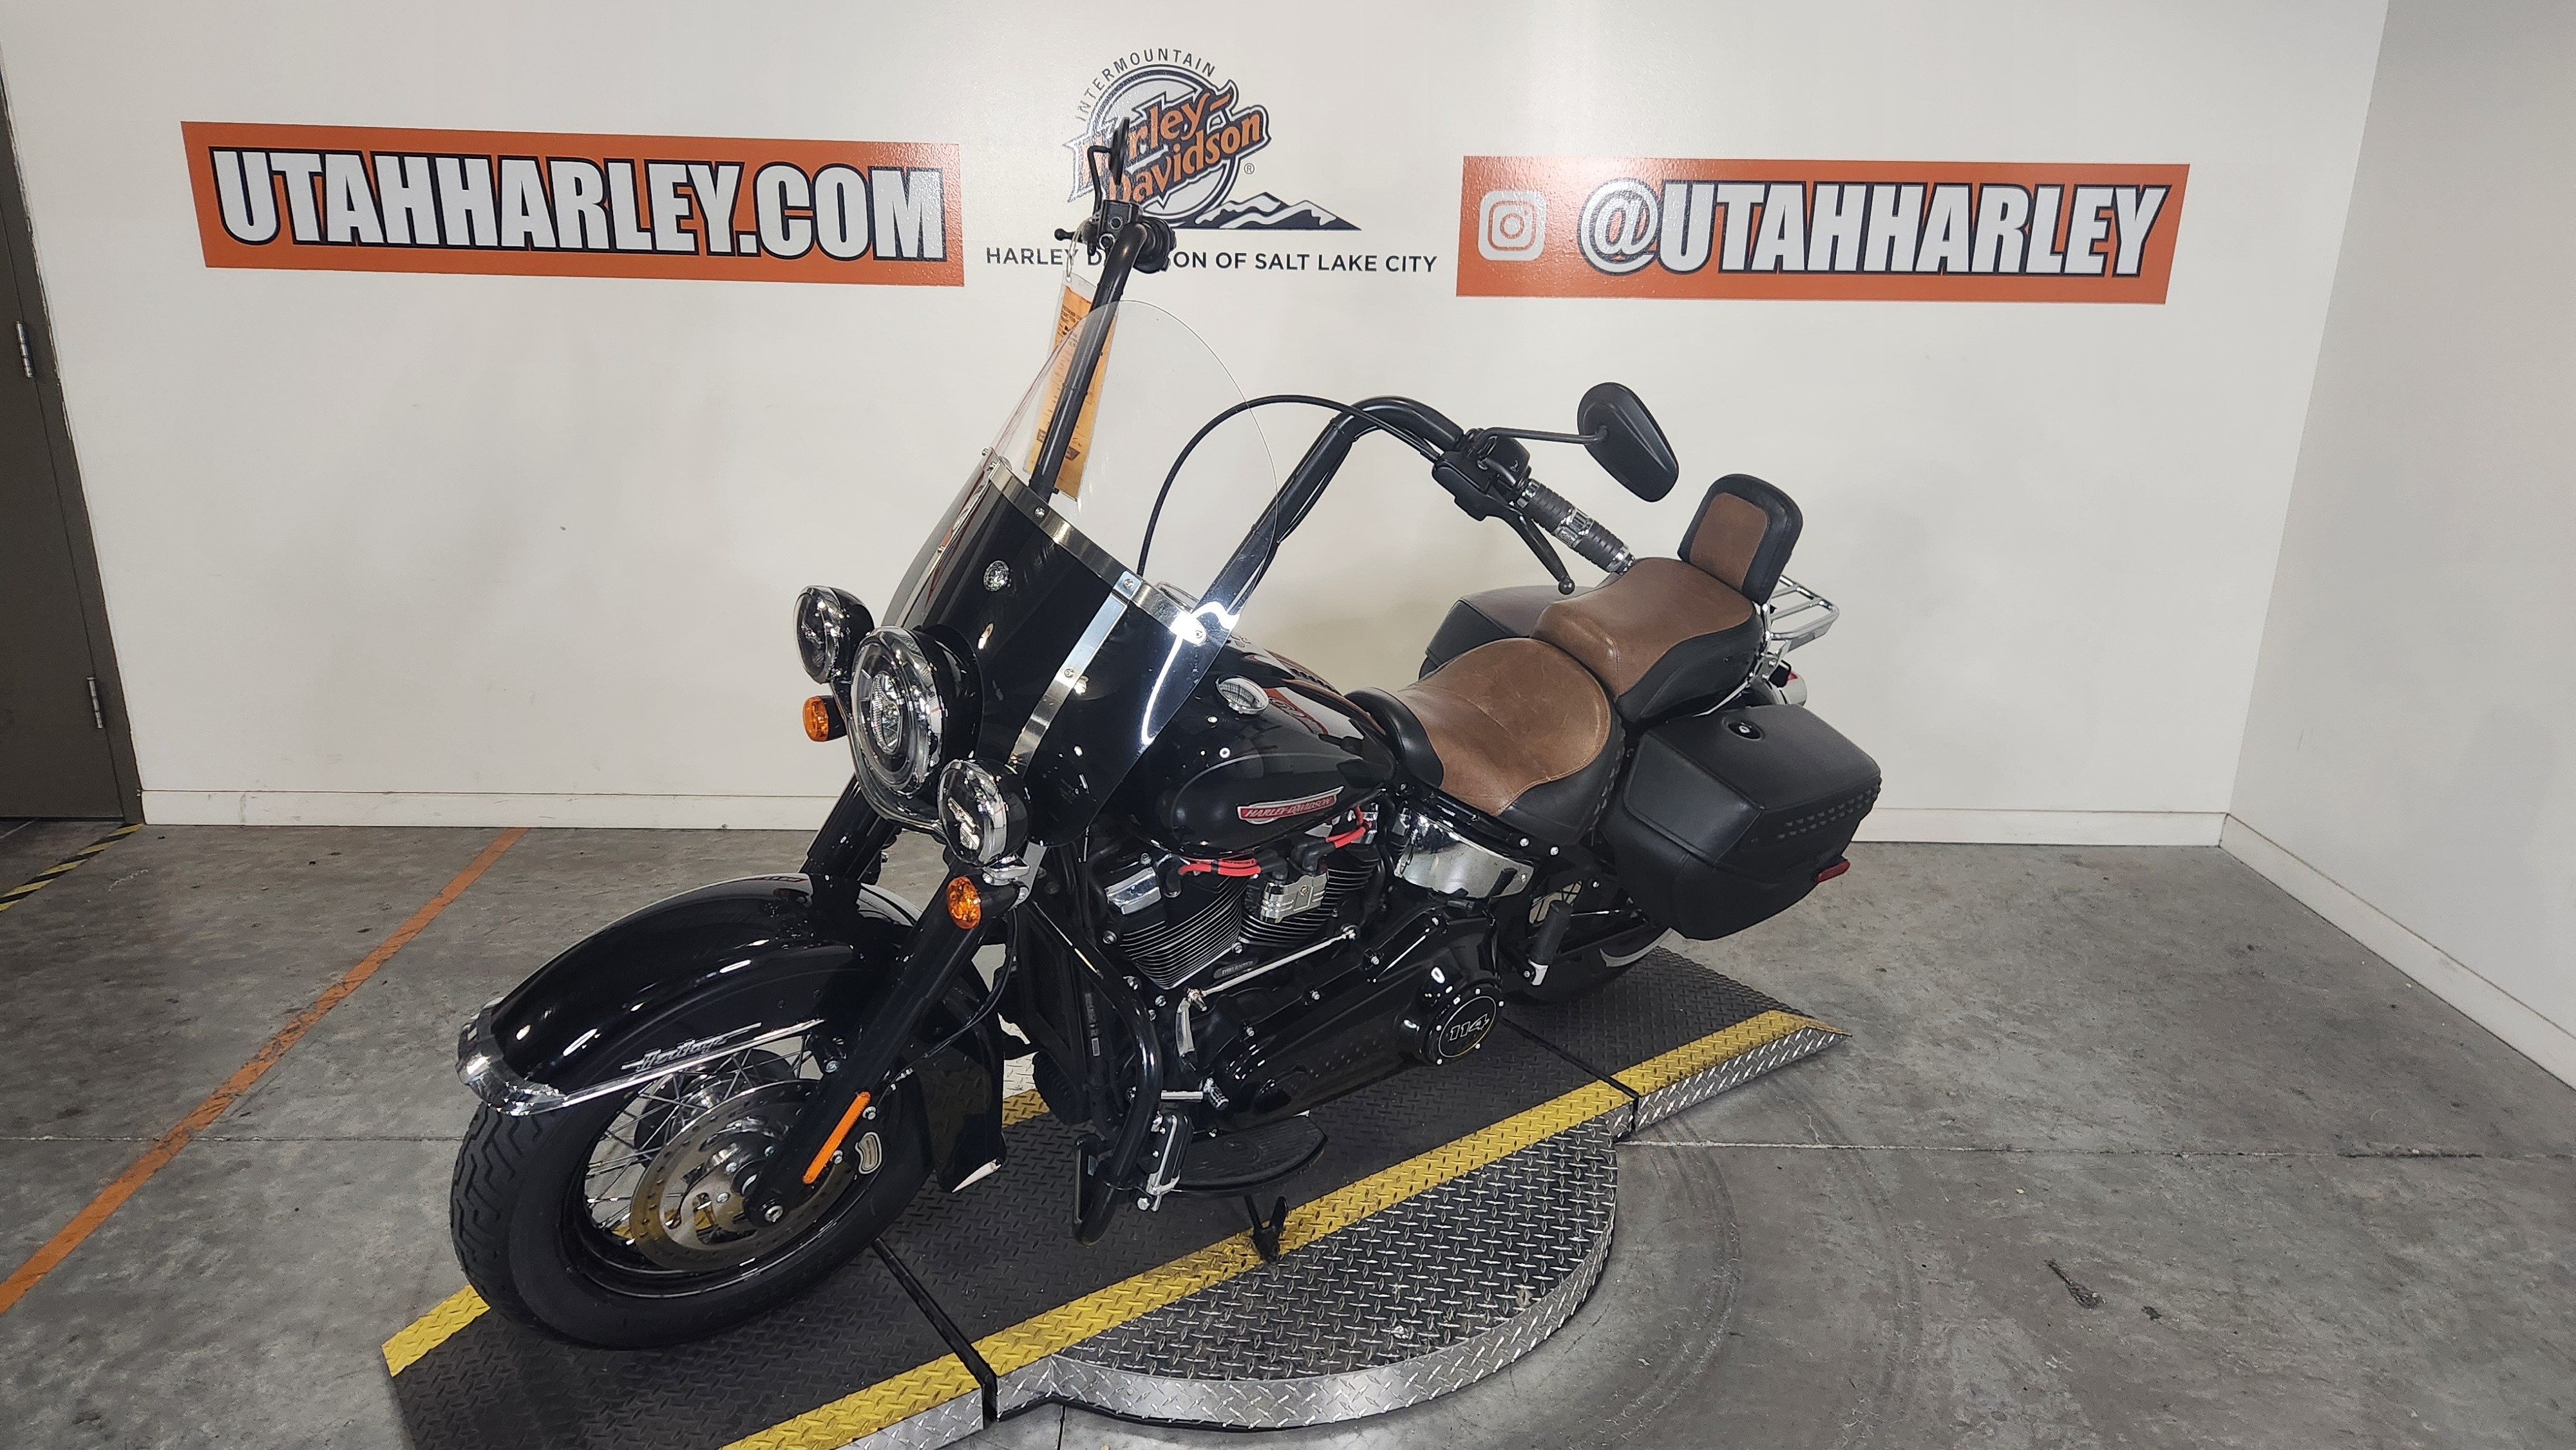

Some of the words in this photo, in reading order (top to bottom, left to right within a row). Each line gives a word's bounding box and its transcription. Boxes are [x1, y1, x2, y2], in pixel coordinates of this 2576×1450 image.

[1075, 48, 1216, 122] INTERMOUNTAIN
[209, 146, 947, 262] UTAHHARLEY.COM
[1577, 178, 2172, 278] @UTAHHARLEY
[986, 247, 1079, 265] HARLEY
[1215, 252, 1247, 269] OF
[1255, 252, 1310, 270] SALT
[1318, 254, 1378, 272] LAKE
[1385, 255, 1437, 272] CITY
[1244, 796, 1332, 818] HARLEY-DAVIDSON
[1449, 1013, 1490, 1041] 114
